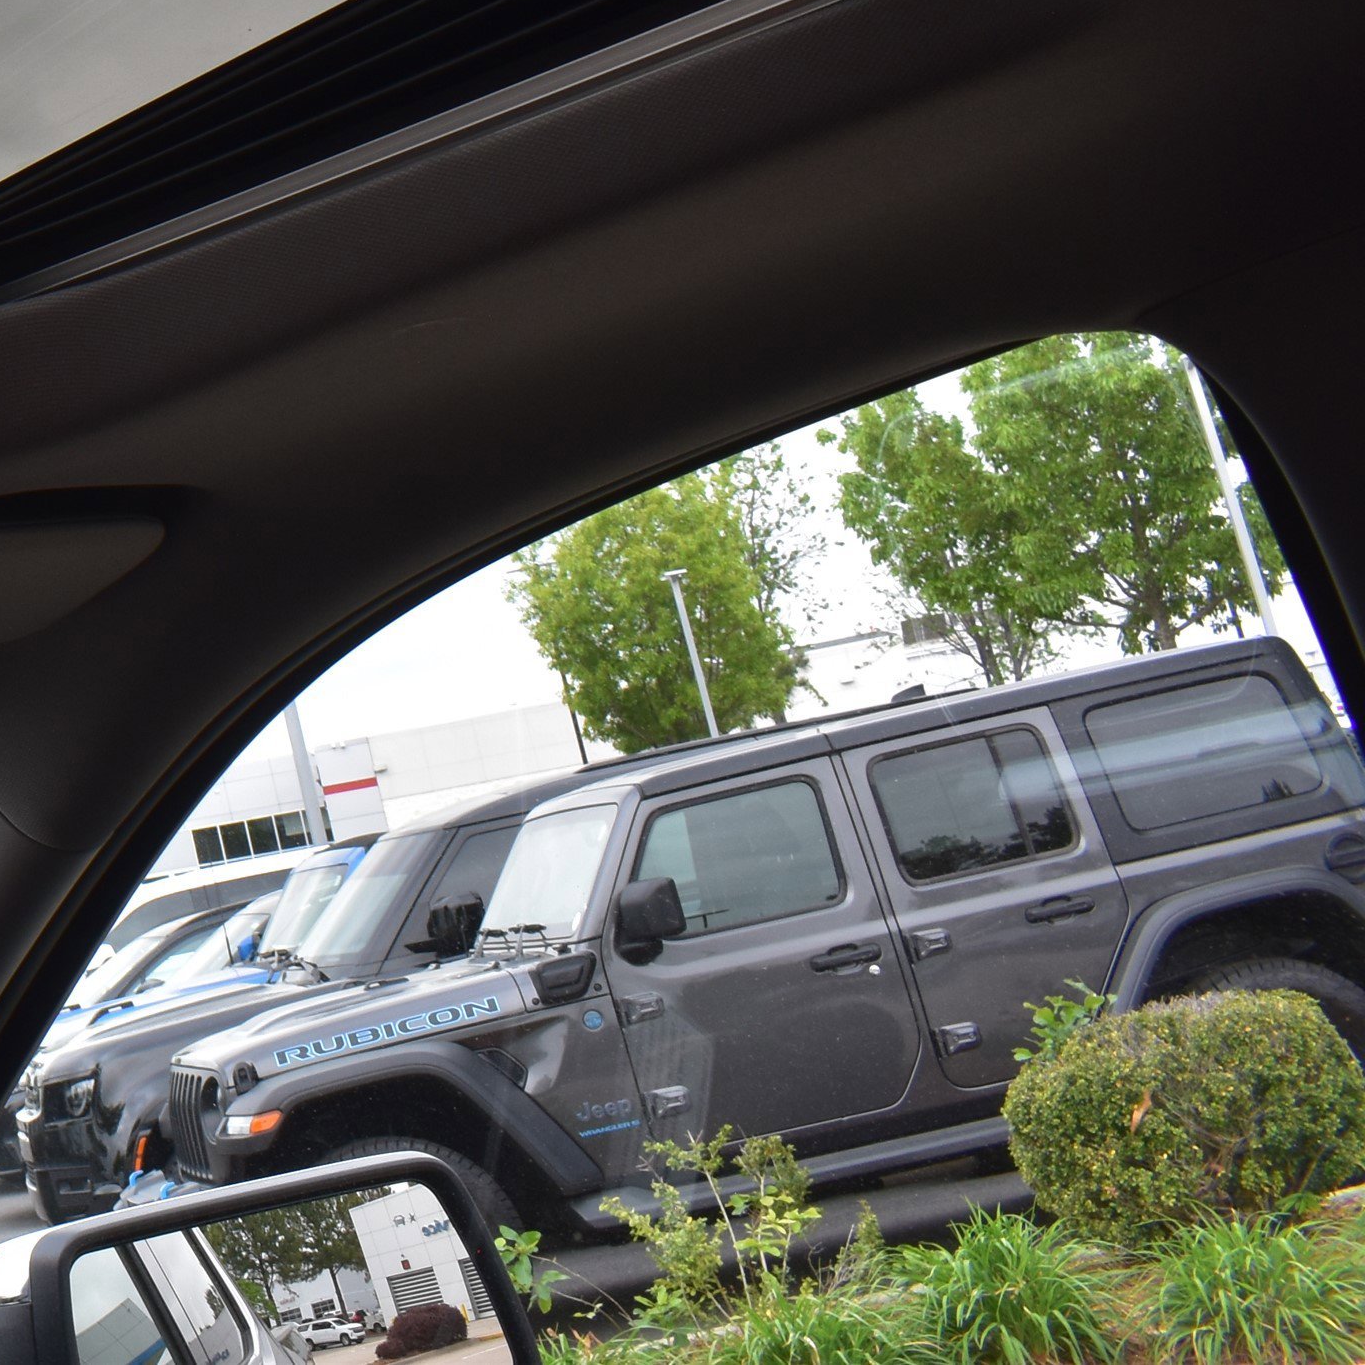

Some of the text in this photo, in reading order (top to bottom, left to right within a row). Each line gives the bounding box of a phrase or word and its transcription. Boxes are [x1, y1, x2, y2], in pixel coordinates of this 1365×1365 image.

[273, 995, 502, 1068] RUBICON
[575, 1098, 632, 1122] Jeep
[578, 1120, 631, 1138] WRANGLER
